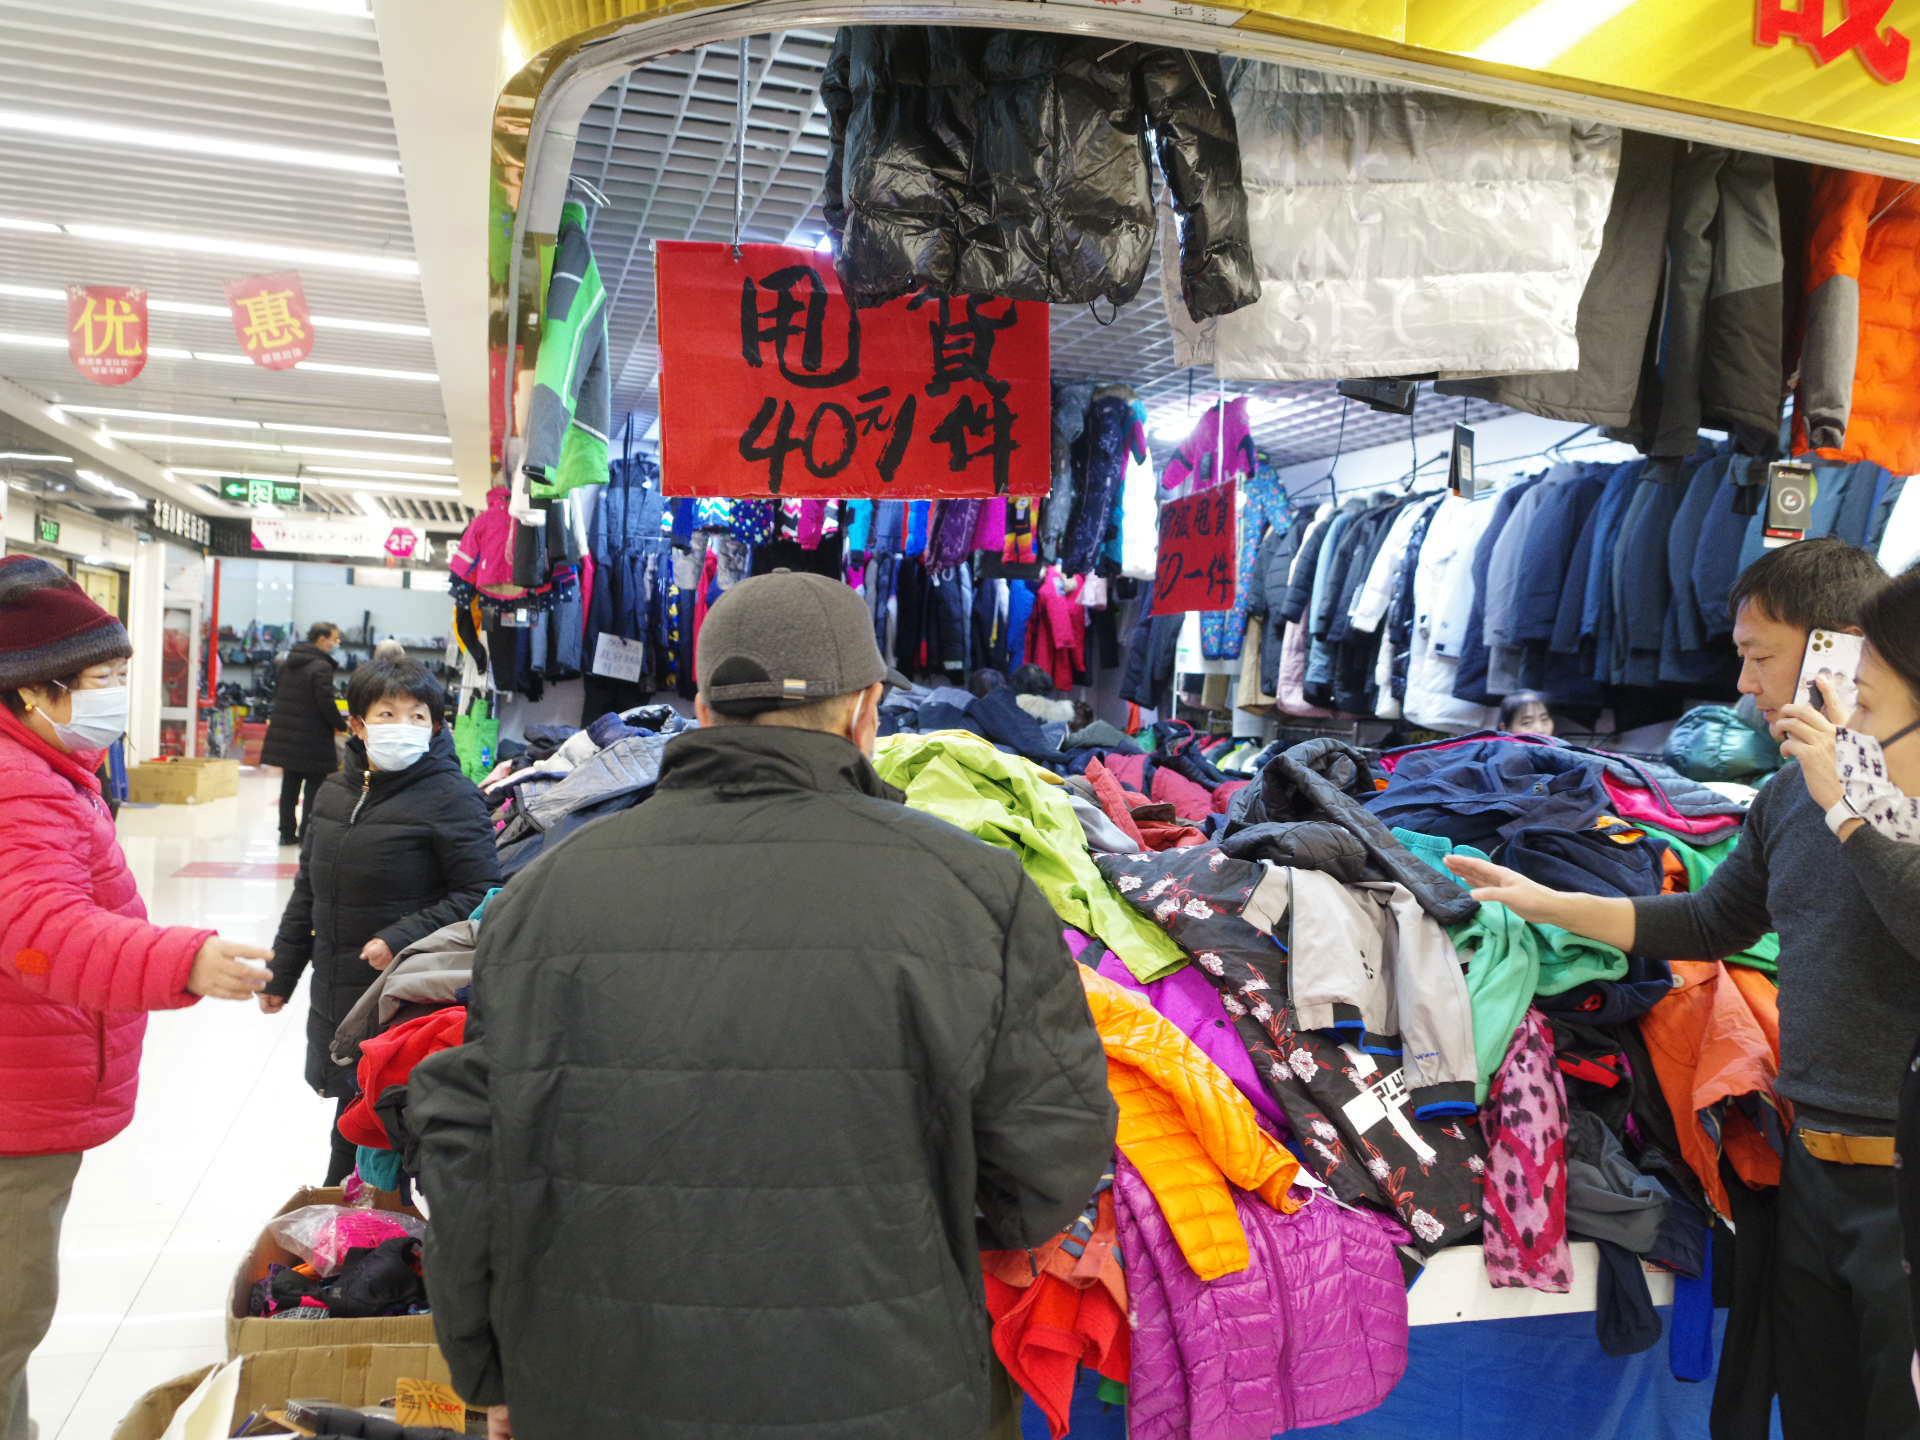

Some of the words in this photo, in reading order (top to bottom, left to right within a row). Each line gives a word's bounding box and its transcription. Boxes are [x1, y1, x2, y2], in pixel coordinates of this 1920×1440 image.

[73, 297, 142, 357] 优
[236, 290, 305, 350] 惠
[390, 534, 413, 552] 2F
